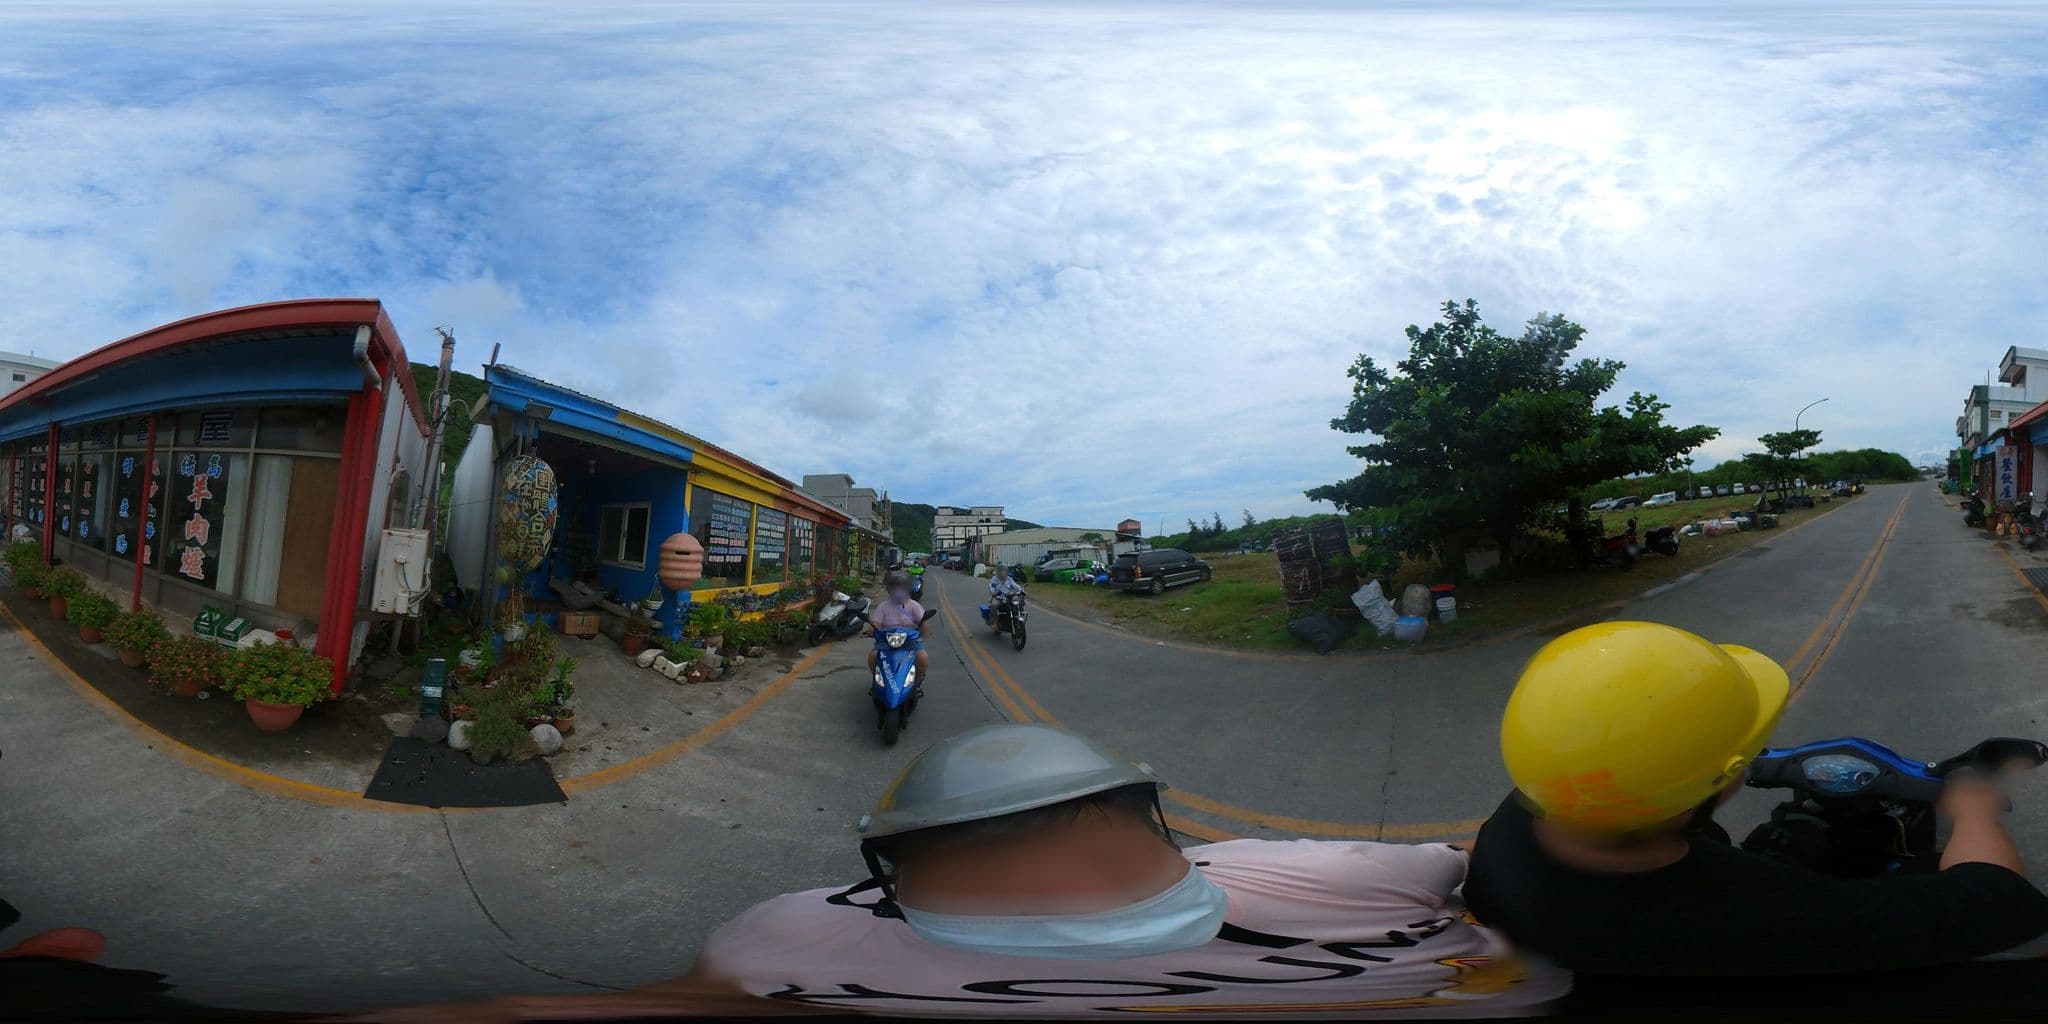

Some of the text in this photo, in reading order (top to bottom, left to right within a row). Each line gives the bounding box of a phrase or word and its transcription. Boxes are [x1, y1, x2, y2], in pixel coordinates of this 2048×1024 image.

[180, 454, 223, 480] 綠島
[179, 473, 213, 581] 羊肉爐
